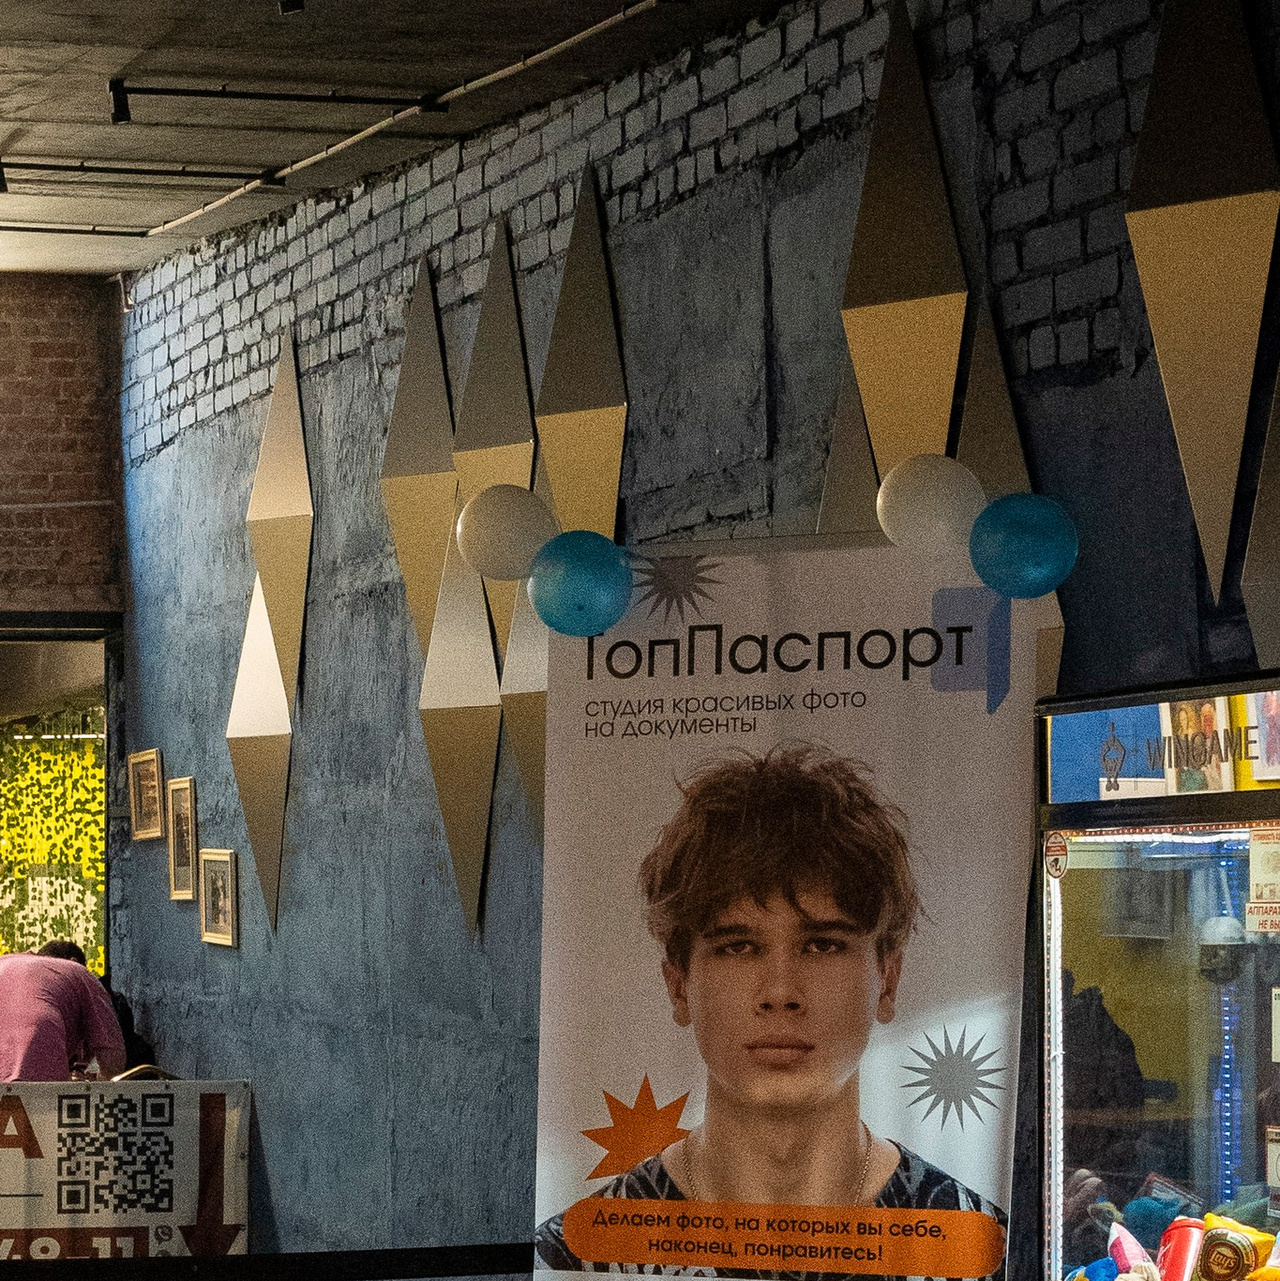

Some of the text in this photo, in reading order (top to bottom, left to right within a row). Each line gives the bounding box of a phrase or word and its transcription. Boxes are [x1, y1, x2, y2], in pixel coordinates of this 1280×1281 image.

[587, 623, 973, 680] ТопПаспорт
[585, 688, 867, 720] студия красивых фото
[585, 715, 757, 739] на документы
[593, 1208, 948, 1240] Делаем фото, на которых вы себе,
[648, 1239, 883, 1263] наконец, понравитесь!
